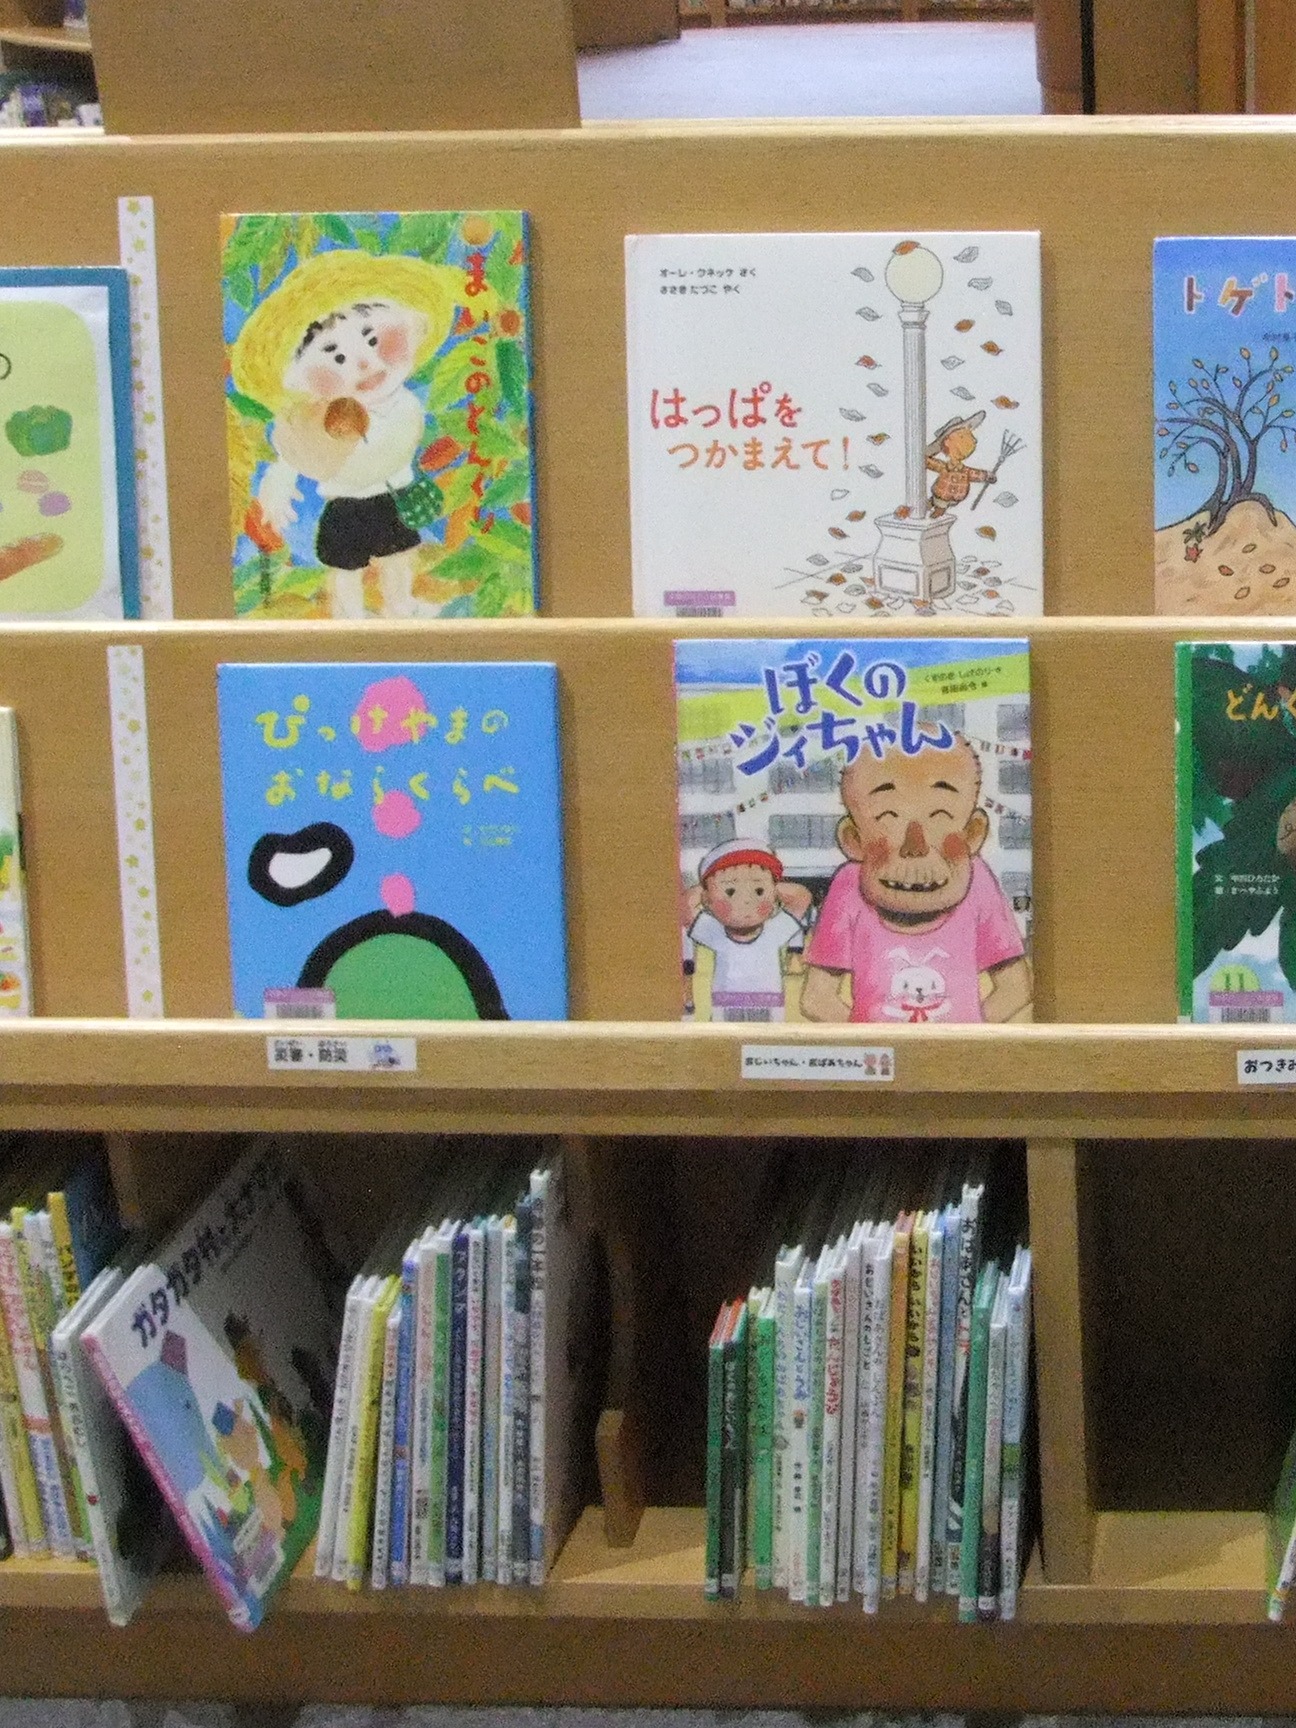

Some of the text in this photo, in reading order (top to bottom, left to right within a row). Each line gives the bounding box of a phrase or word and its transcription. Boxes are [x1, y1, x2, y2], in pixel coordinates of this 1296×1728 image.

[650, 381, 803, 429] はっぱを
[762, 649, 908, 716] ぼくの
[729, 701, 954, 776] ジィちゃん
